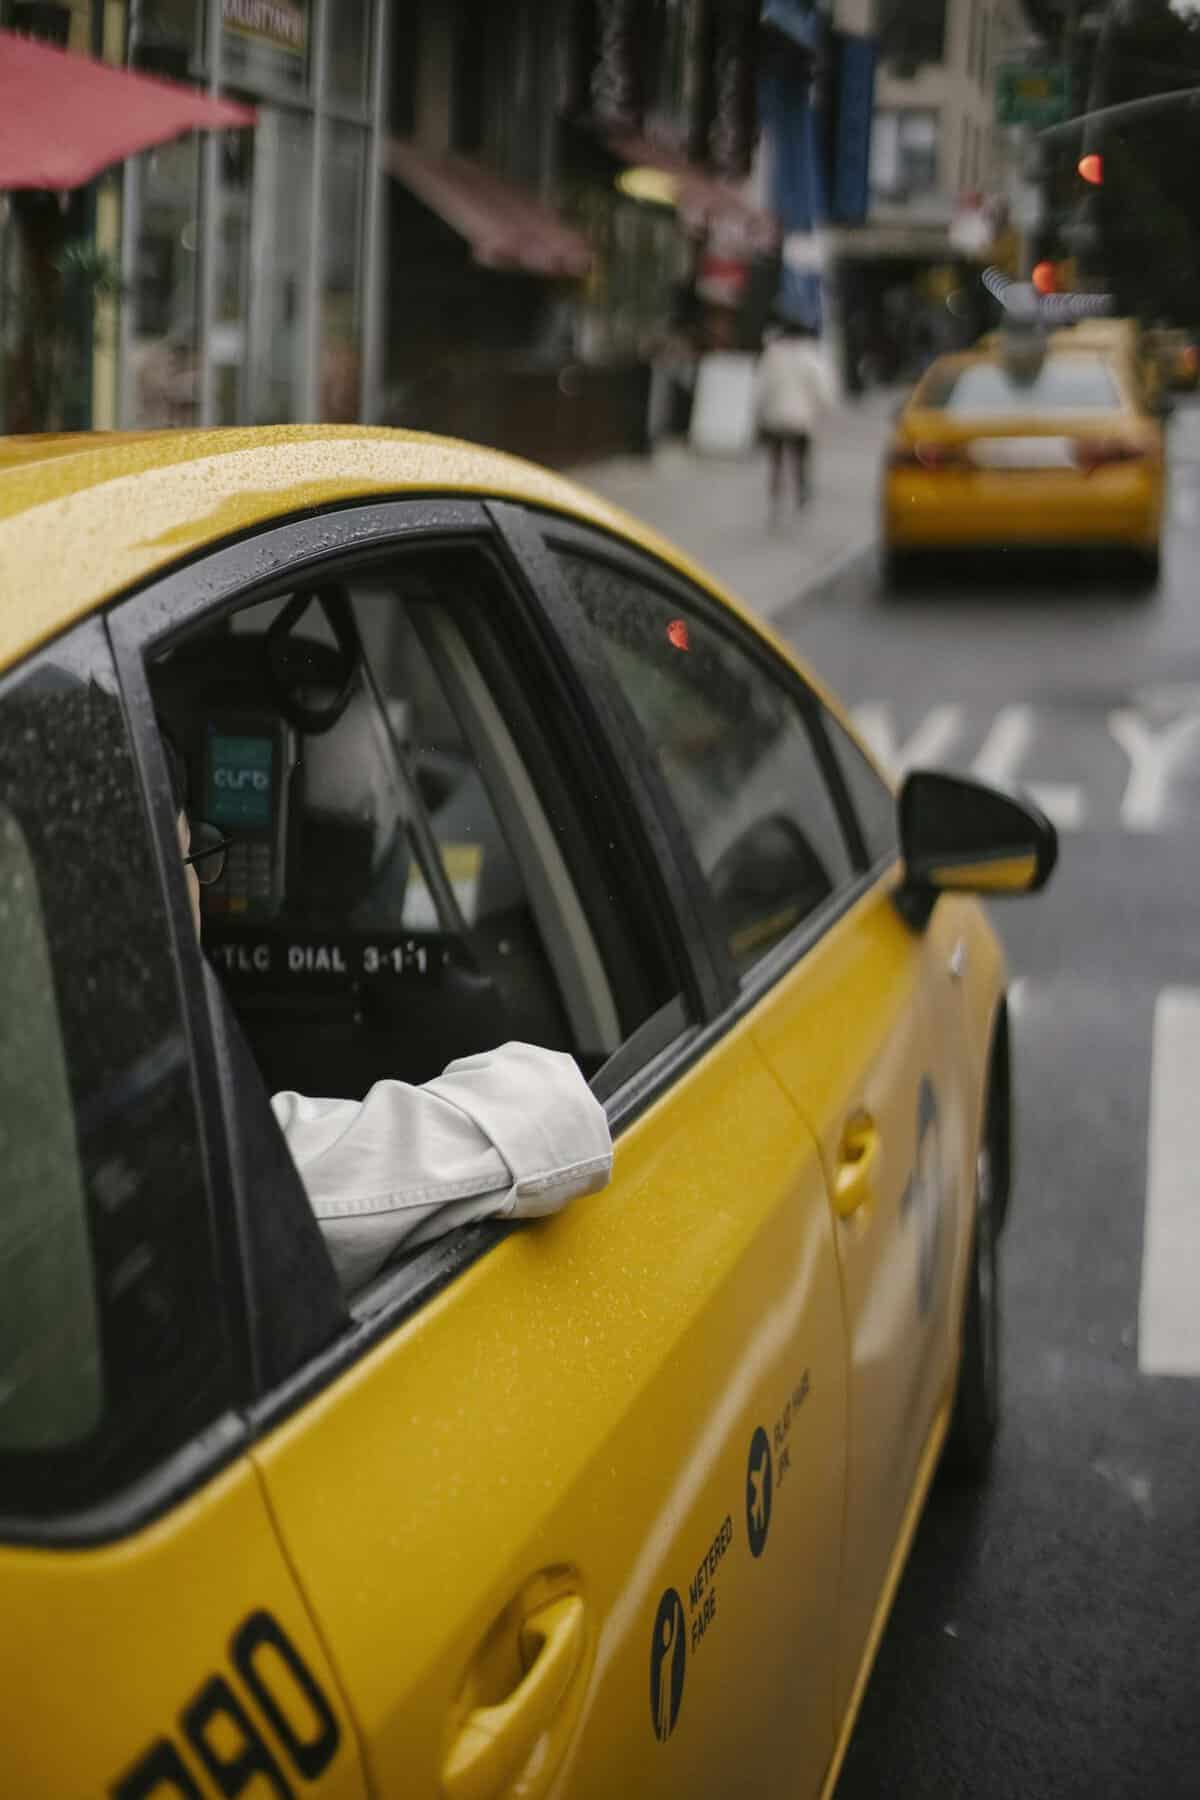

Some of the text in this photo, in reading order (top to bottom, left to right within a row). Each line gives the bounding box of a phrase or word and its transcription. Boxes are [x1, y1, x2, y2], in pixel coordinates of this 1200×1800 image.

[224, 944, 271, 972] TLC
[287, 945, 346, 972] DIAL
[689, 1513, 733, 1614] METERED
[691, 1586, 717, 1656] FARE
